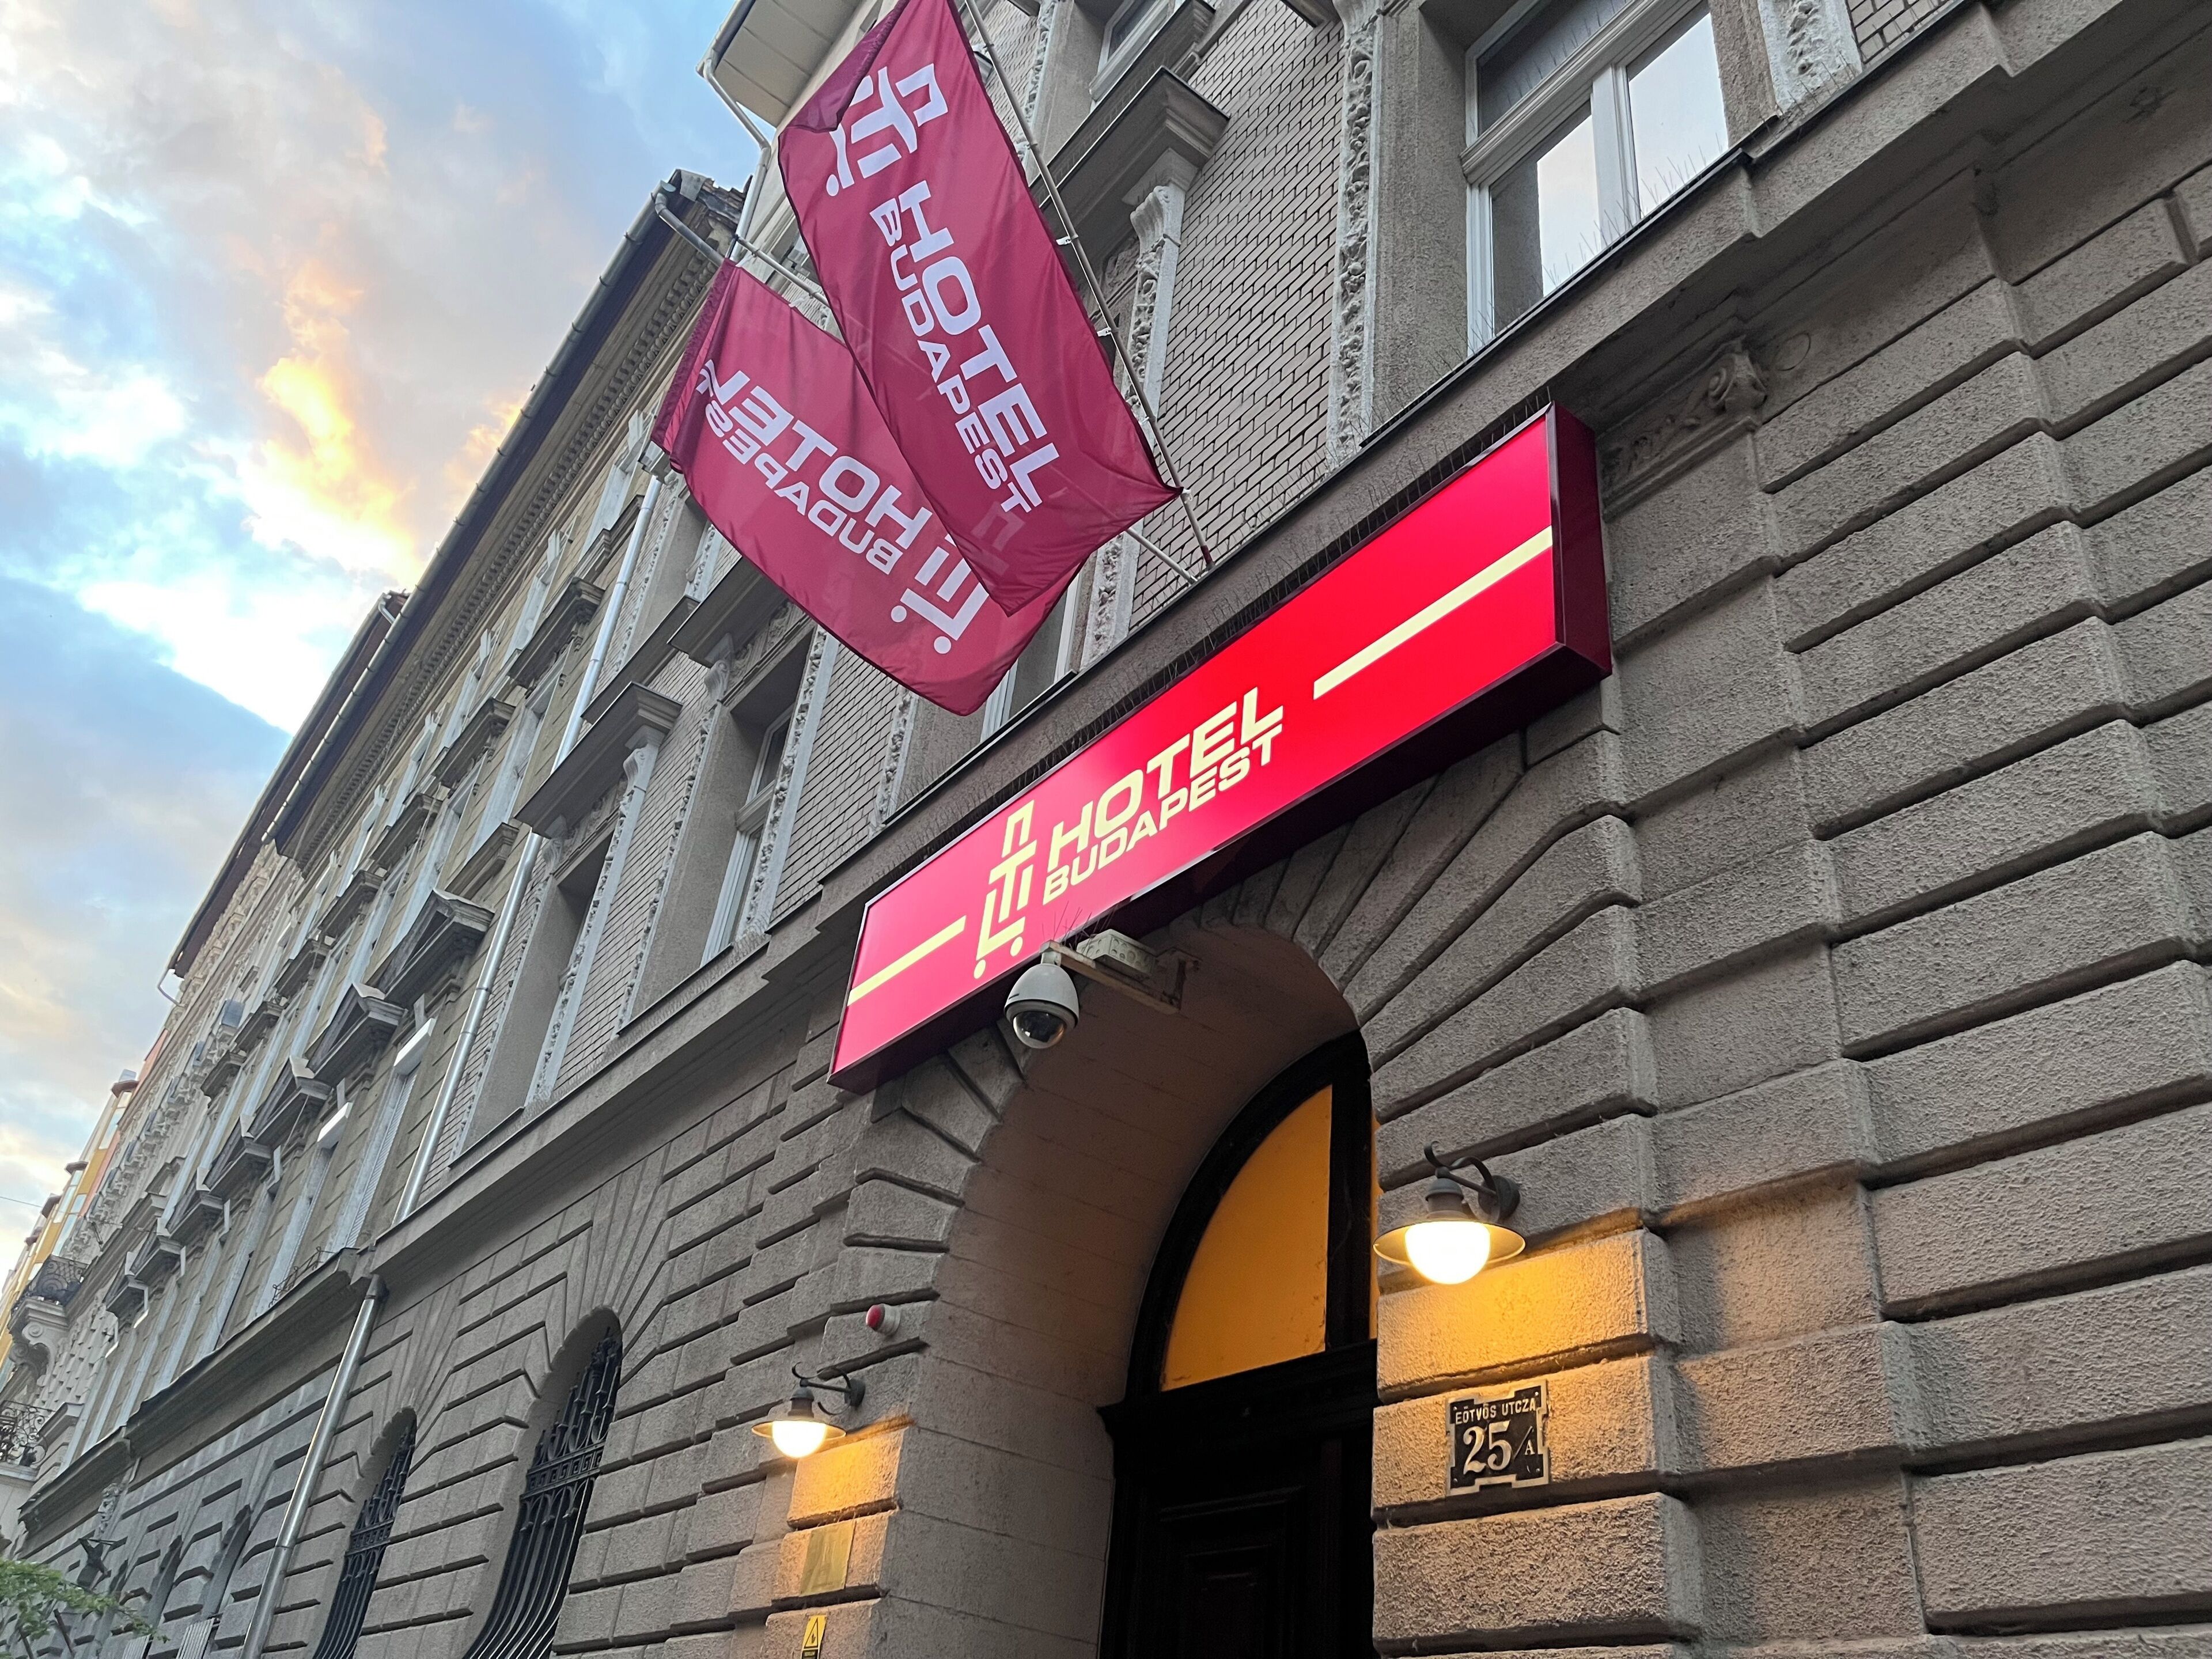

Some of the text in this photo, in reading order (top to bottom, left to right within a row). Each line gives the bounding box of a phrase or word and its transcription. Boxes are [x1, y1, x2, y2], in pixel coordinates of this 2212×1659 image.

[870, 198, 1032, 513] BUDAPEST
[898, 180, 1059, 508] HOTEL
[1043, 724, 1283, 905] BUDAPEST
[1047, 687, 1283, 873] HOTEL
[1502, 1397, 1536, 1416] UTCZA
